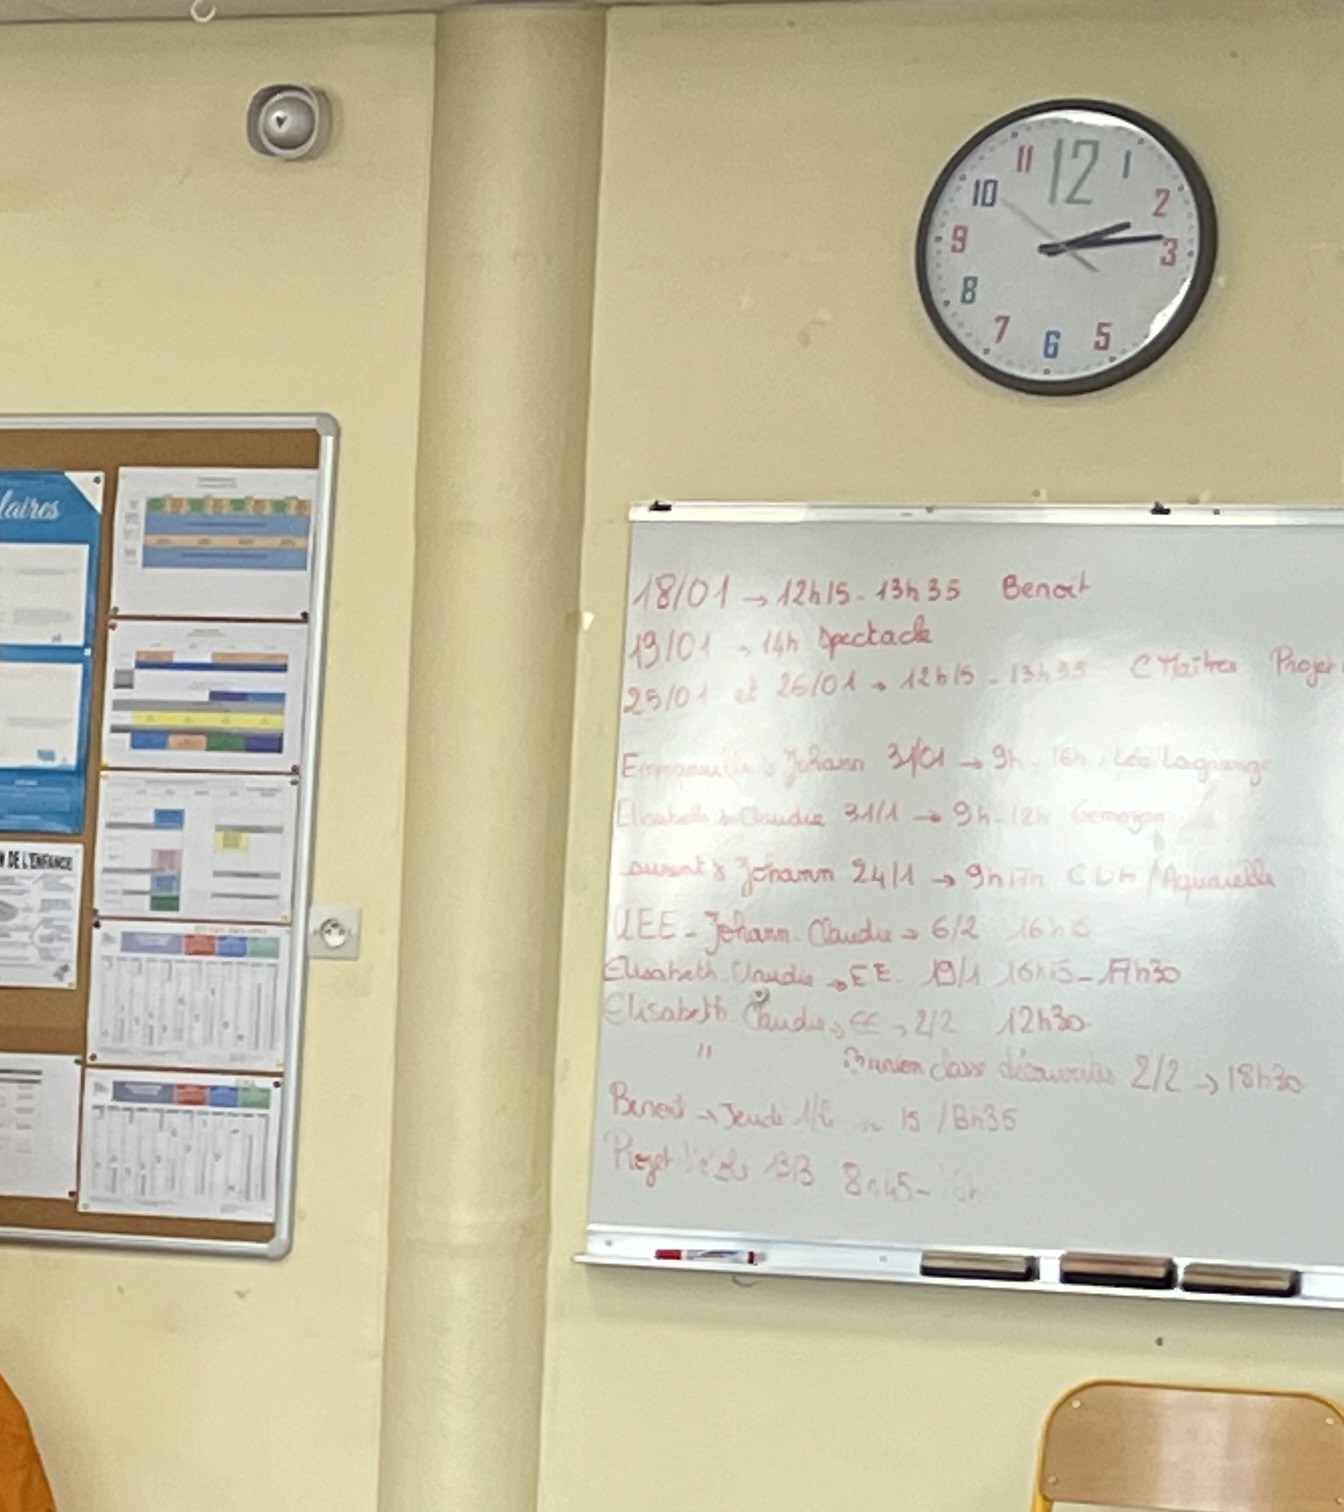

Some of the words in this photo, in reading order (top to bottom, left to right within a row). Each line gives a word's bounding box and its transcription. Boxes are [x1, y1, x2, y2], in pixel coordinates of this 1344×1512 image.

[1016, 144, 1034, 174] 11
[1048, 138, 1100, 205] 12
[1122, 149, 1132, 179] 1
[972, 178, 998, 208] 10
[1152, 187, 1171, 217] 2
[950, 225, 969, 254] 9
[1160, 237, 1179, 267] 3
[960, 275, 979, 305] 8
[994, 315, 1011, 344] 7
[1043, 329, 1061, 360] 6
[1093, 321, 1113, 352] 5
[633, 573, 730, 610] 18/01
[777, 578, 850, 606] 12h15
[628, 630, 710, 670] 19/01
[623, 683, 708, 716] 25/01
[777, 670, 857, 699] 26/01
[899, 665, 976, 690] 12h15
[844, 800, 899, 824] 31/1
[623, 855, 705, 877] aurent
[851, 858, 916, 890] 24/1
[930, 912, 979, 944] 6/2
[1130, 1052, 1181, 1093] 2/2
